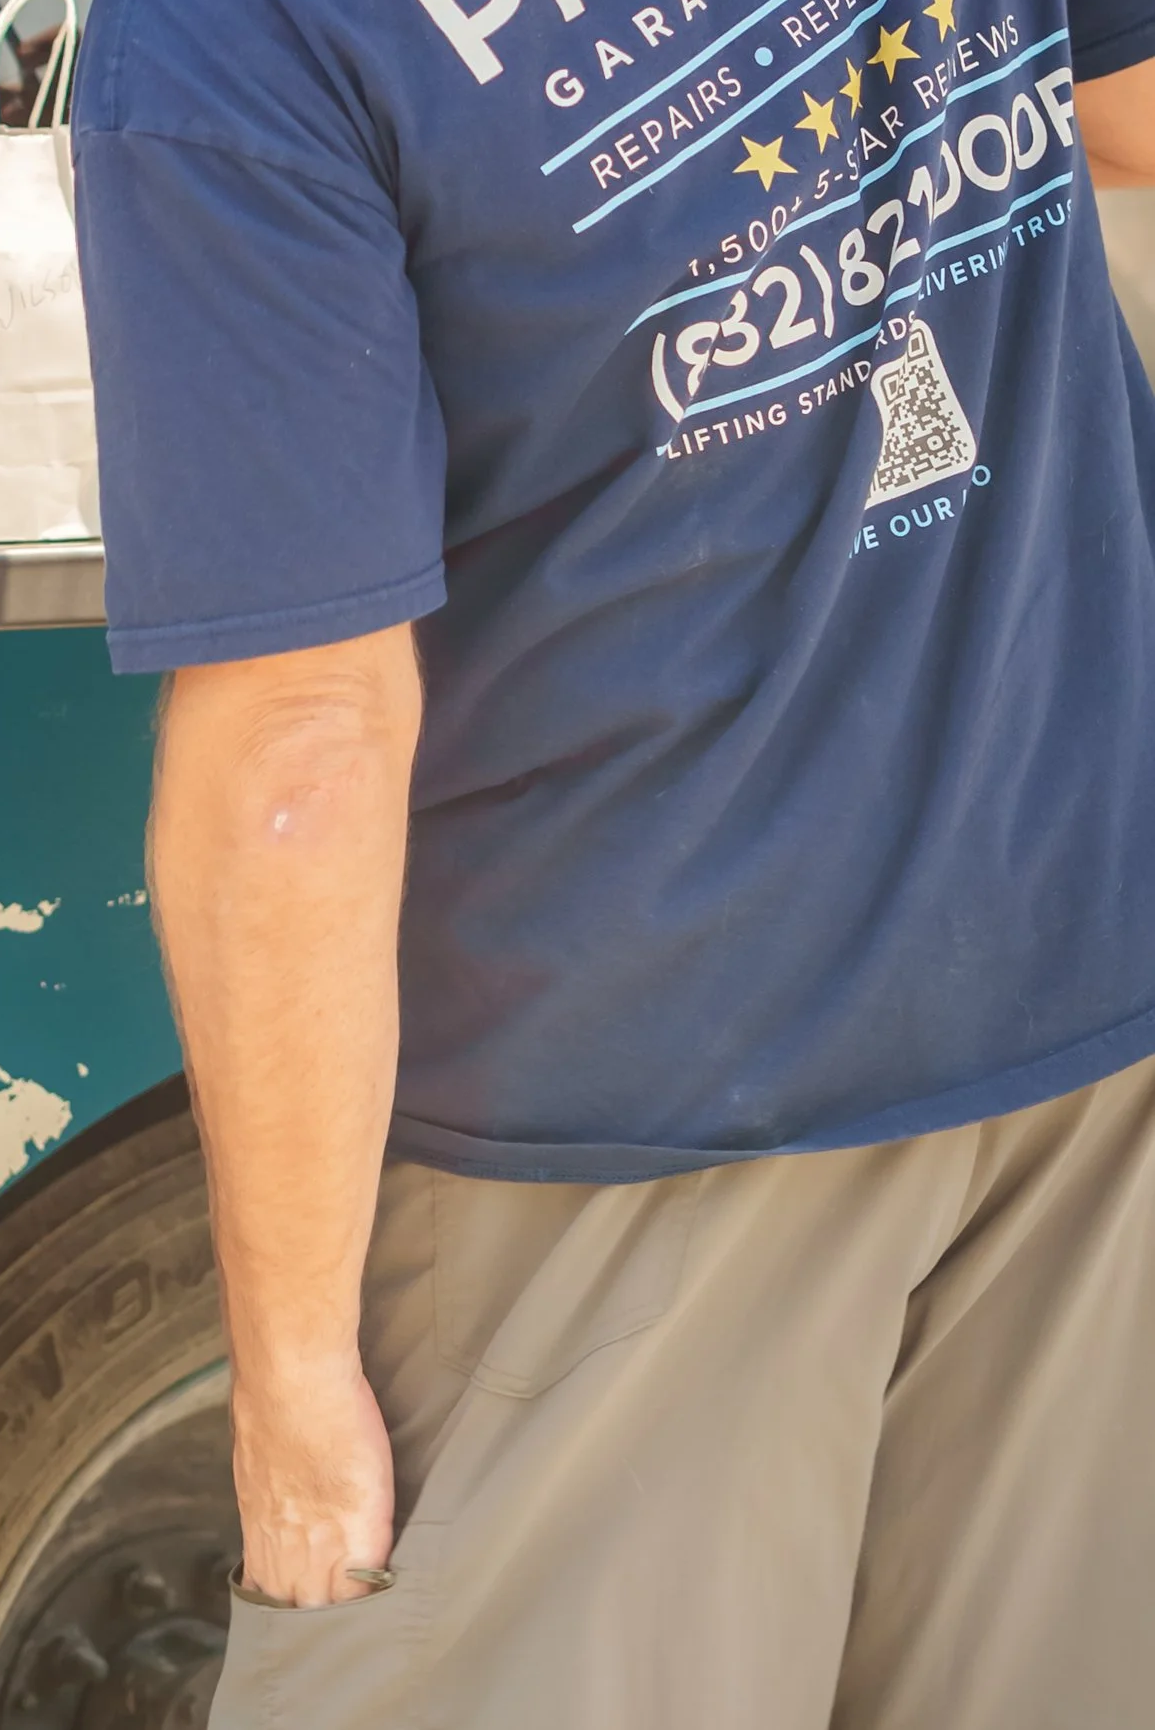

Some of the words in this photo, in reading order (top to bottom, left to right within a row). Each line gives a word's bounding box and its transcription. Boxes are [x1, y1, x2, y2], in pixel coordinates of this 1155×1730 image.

[590, 66, 742, 189] REPAIRS
[666, 403, 788, 460] LIFTING
[889, 496, 956, 538] OUR
